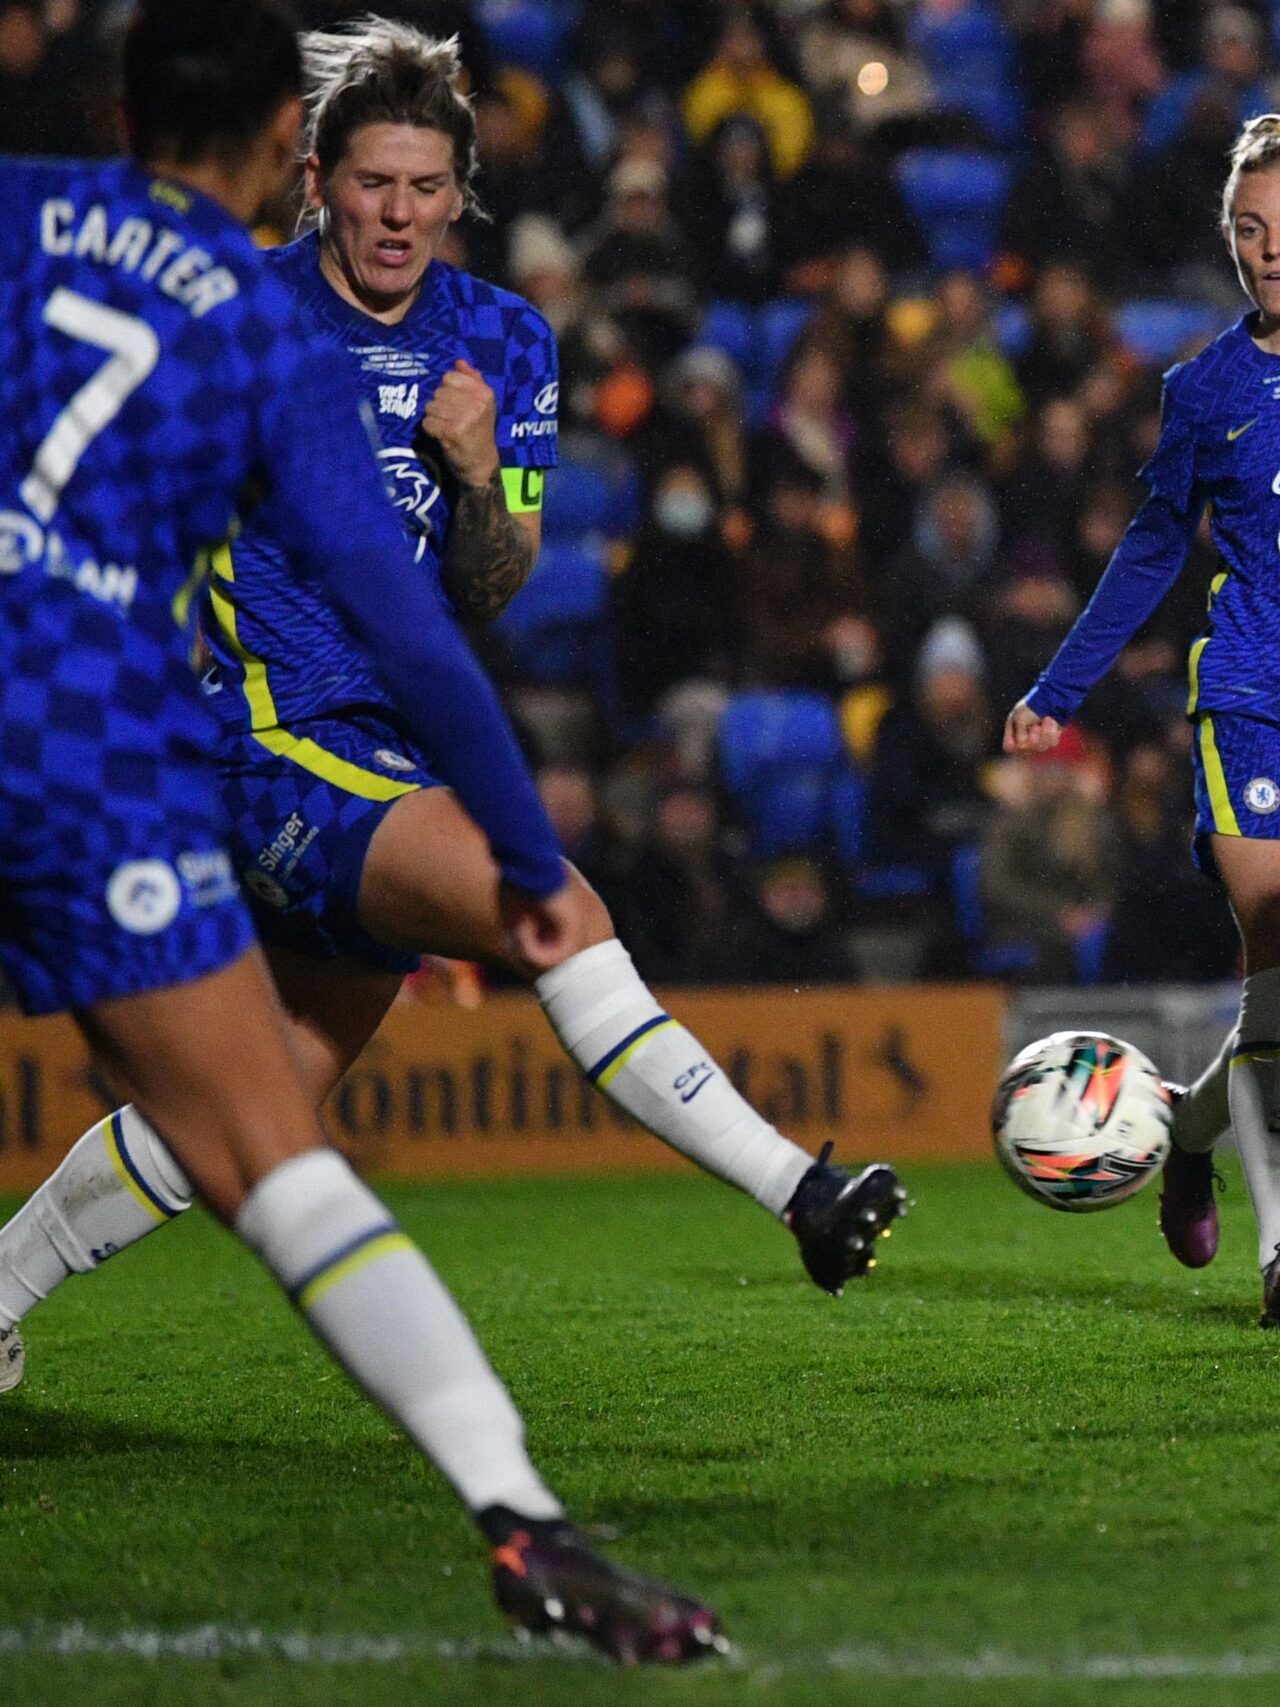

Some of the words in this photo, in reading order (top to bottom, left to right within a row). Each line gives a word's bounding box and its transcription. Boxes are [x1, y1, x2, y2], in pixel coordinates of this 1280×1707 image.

[40, 197, 240, 318] CARTER
[19, 285, 160, 526] 7
[520, 467, 543, 506] C
[258, 812, 304, 871] Singer
